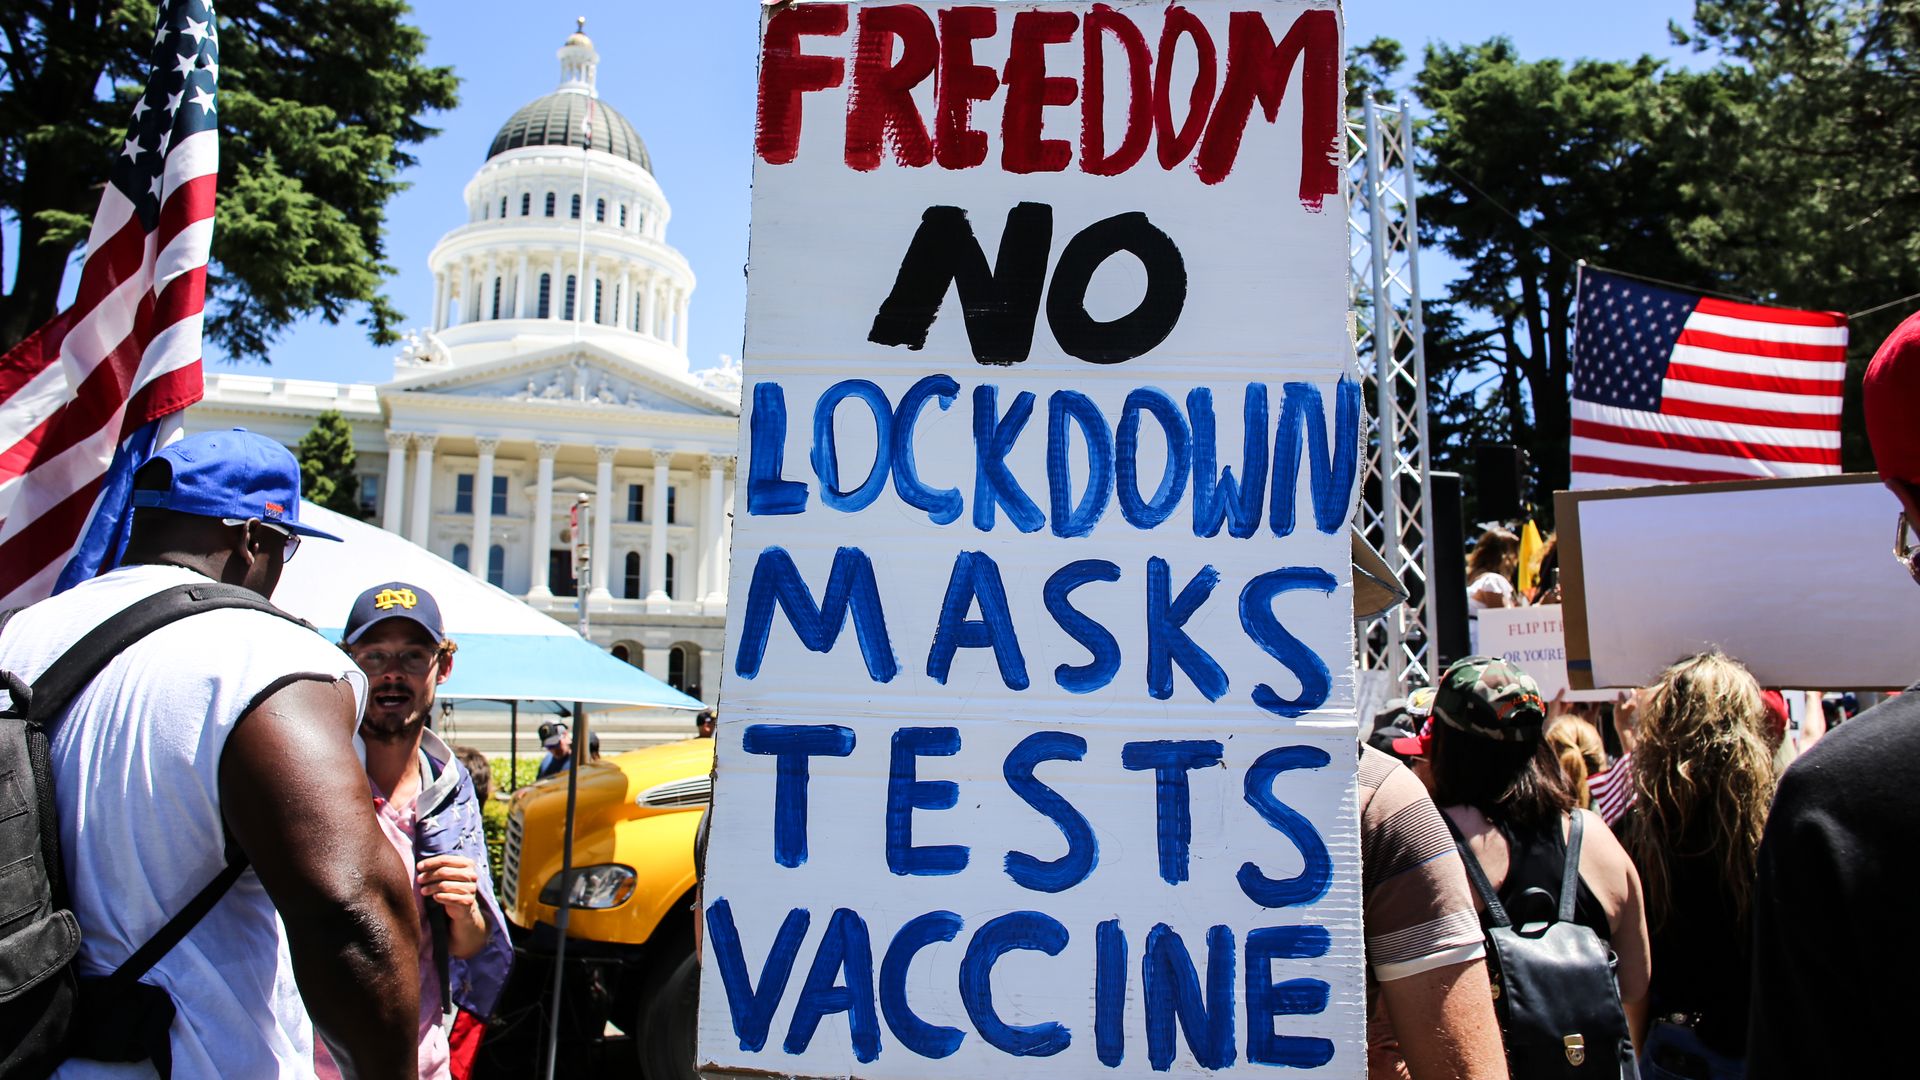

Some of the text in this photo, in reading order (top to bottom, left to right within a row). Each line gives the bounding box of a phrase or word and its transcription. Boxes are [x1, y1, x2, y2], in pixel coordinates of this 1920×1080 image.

[756, 2, 1339, 209] FREEDOM
[868, 201, 1187, 366] NO
[747, 372, 1361, 539] LOCKDOWN
[735, 546, 1337, 718] MASKS
[1503, 648, 1565, 662] OR YOURE
[1508, 622, 1540, 636] FLIP
[1543, 620, 1556, 633] IT
[743, 724, 1334, 908] TESTS
[706, 896, 1335, 1072] VACCINE
